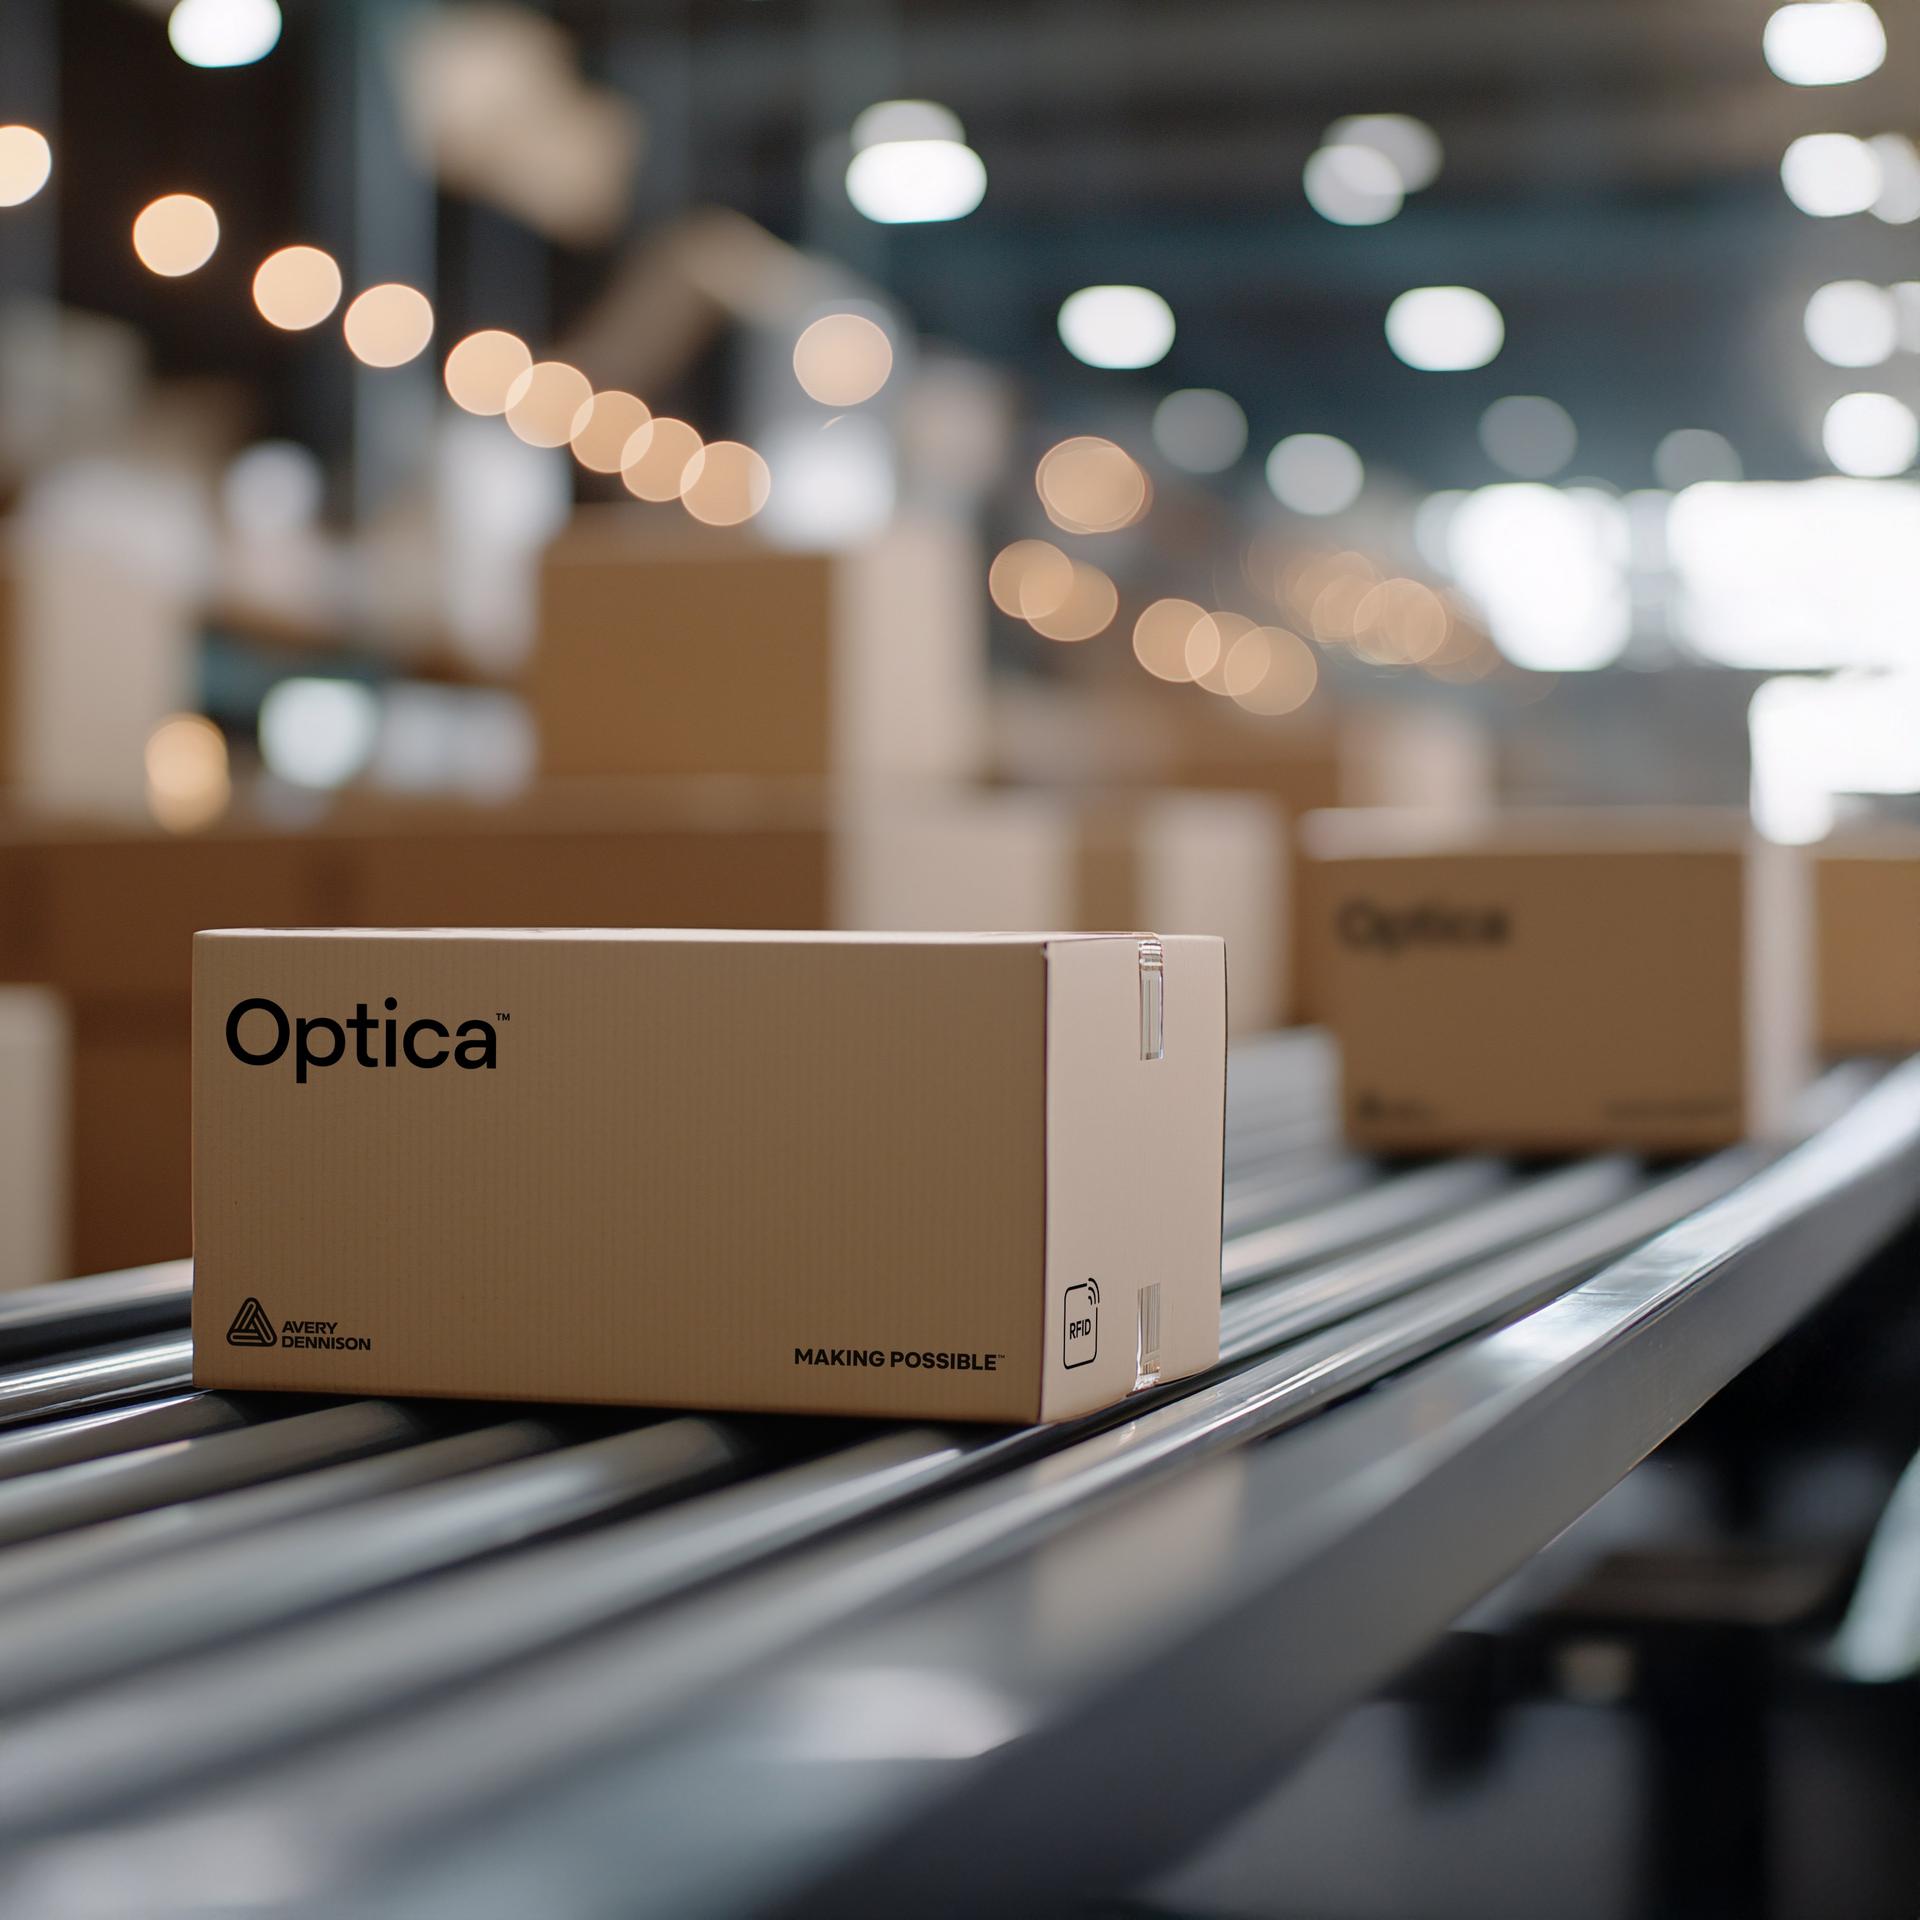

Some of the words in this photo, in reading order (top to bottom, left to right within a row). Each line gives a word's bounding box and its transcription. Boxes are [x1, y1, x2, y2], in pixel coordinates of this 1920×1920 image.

[282, 1321, 338, 1334] AVERY
[1069, 1318, 1092, 1340] RFID
[282, 1336, 371, 1350] DENNISON
[794, 1348, 885, 1367] MAKING
